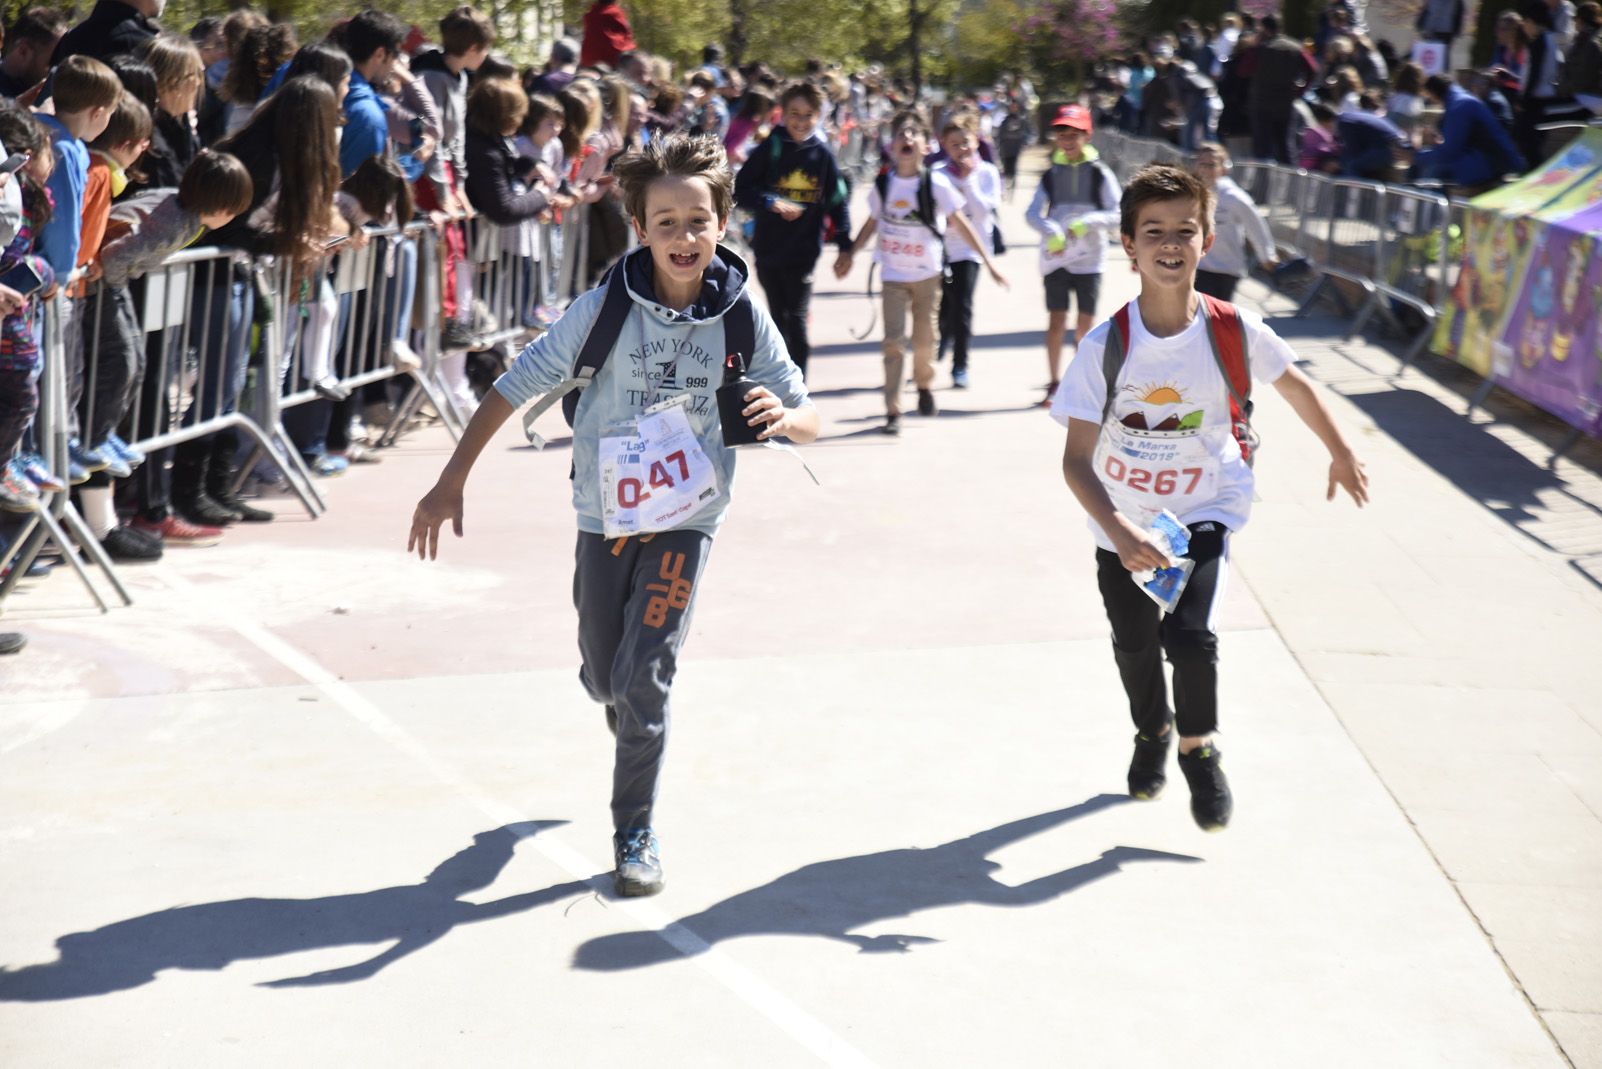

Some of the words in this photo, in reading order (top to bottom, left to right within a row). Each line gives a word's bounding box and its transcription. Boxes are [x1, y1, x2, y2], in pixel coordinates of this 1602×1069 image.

[629, 338, 666, 364] NEW
[672, 338, 713, 368] YORK
[632, 367, 661, 380] since
[686, 376, 708, 388] 999
[1105, 455, 1203, 496] 0267
